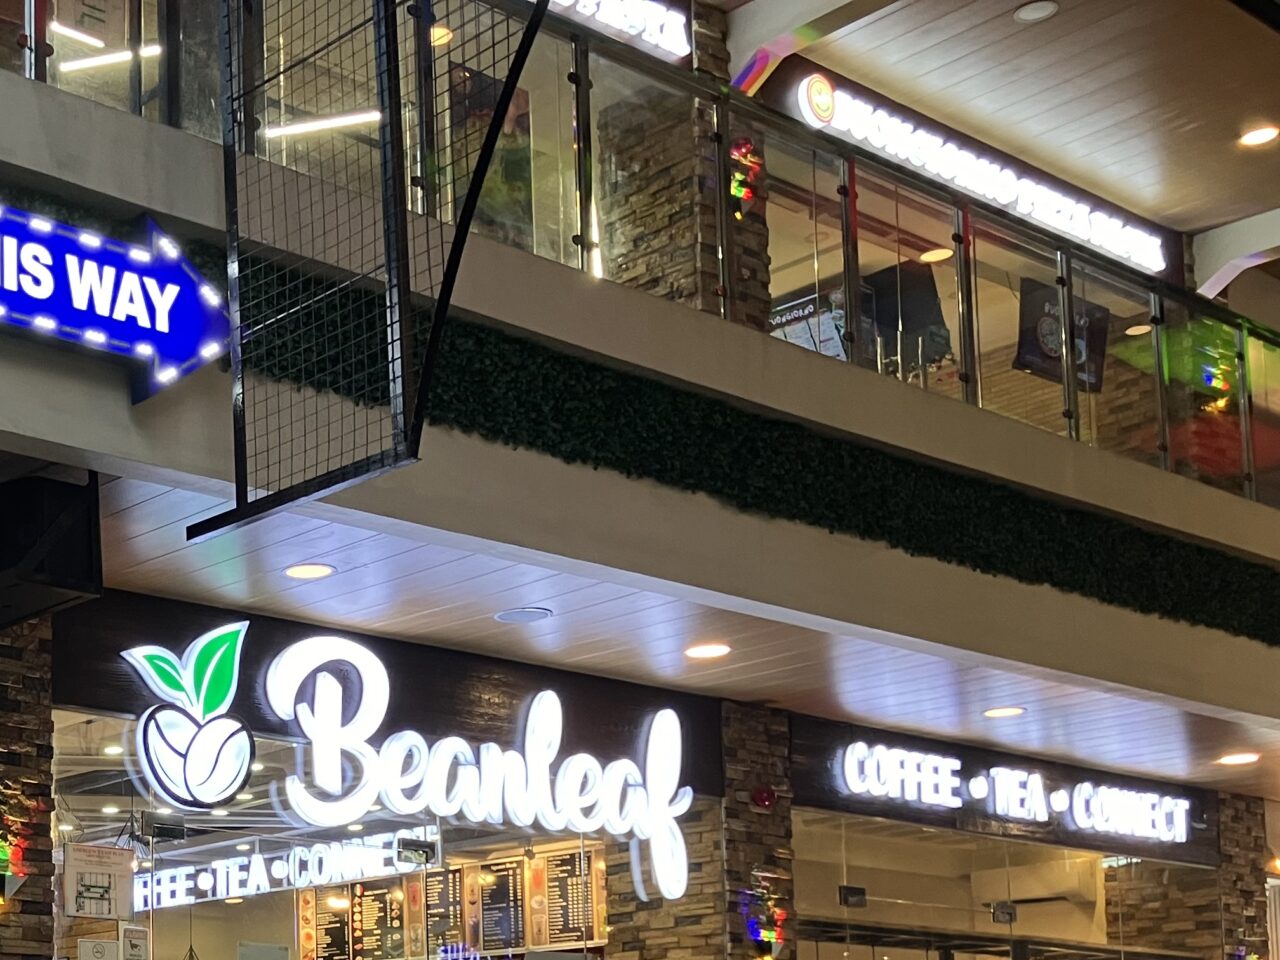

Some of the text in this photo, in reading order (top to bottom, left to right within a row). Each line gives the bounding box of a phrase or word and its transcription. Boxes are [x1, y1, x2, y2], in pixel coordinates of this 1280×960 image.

[66, 252, 181, 333] WAY
[265, 635, 692, 900] Beanleaf
[844, 742, 1190, 843] COFFEE TEA CONNECT
[212, 854, 271, 897] TEA
